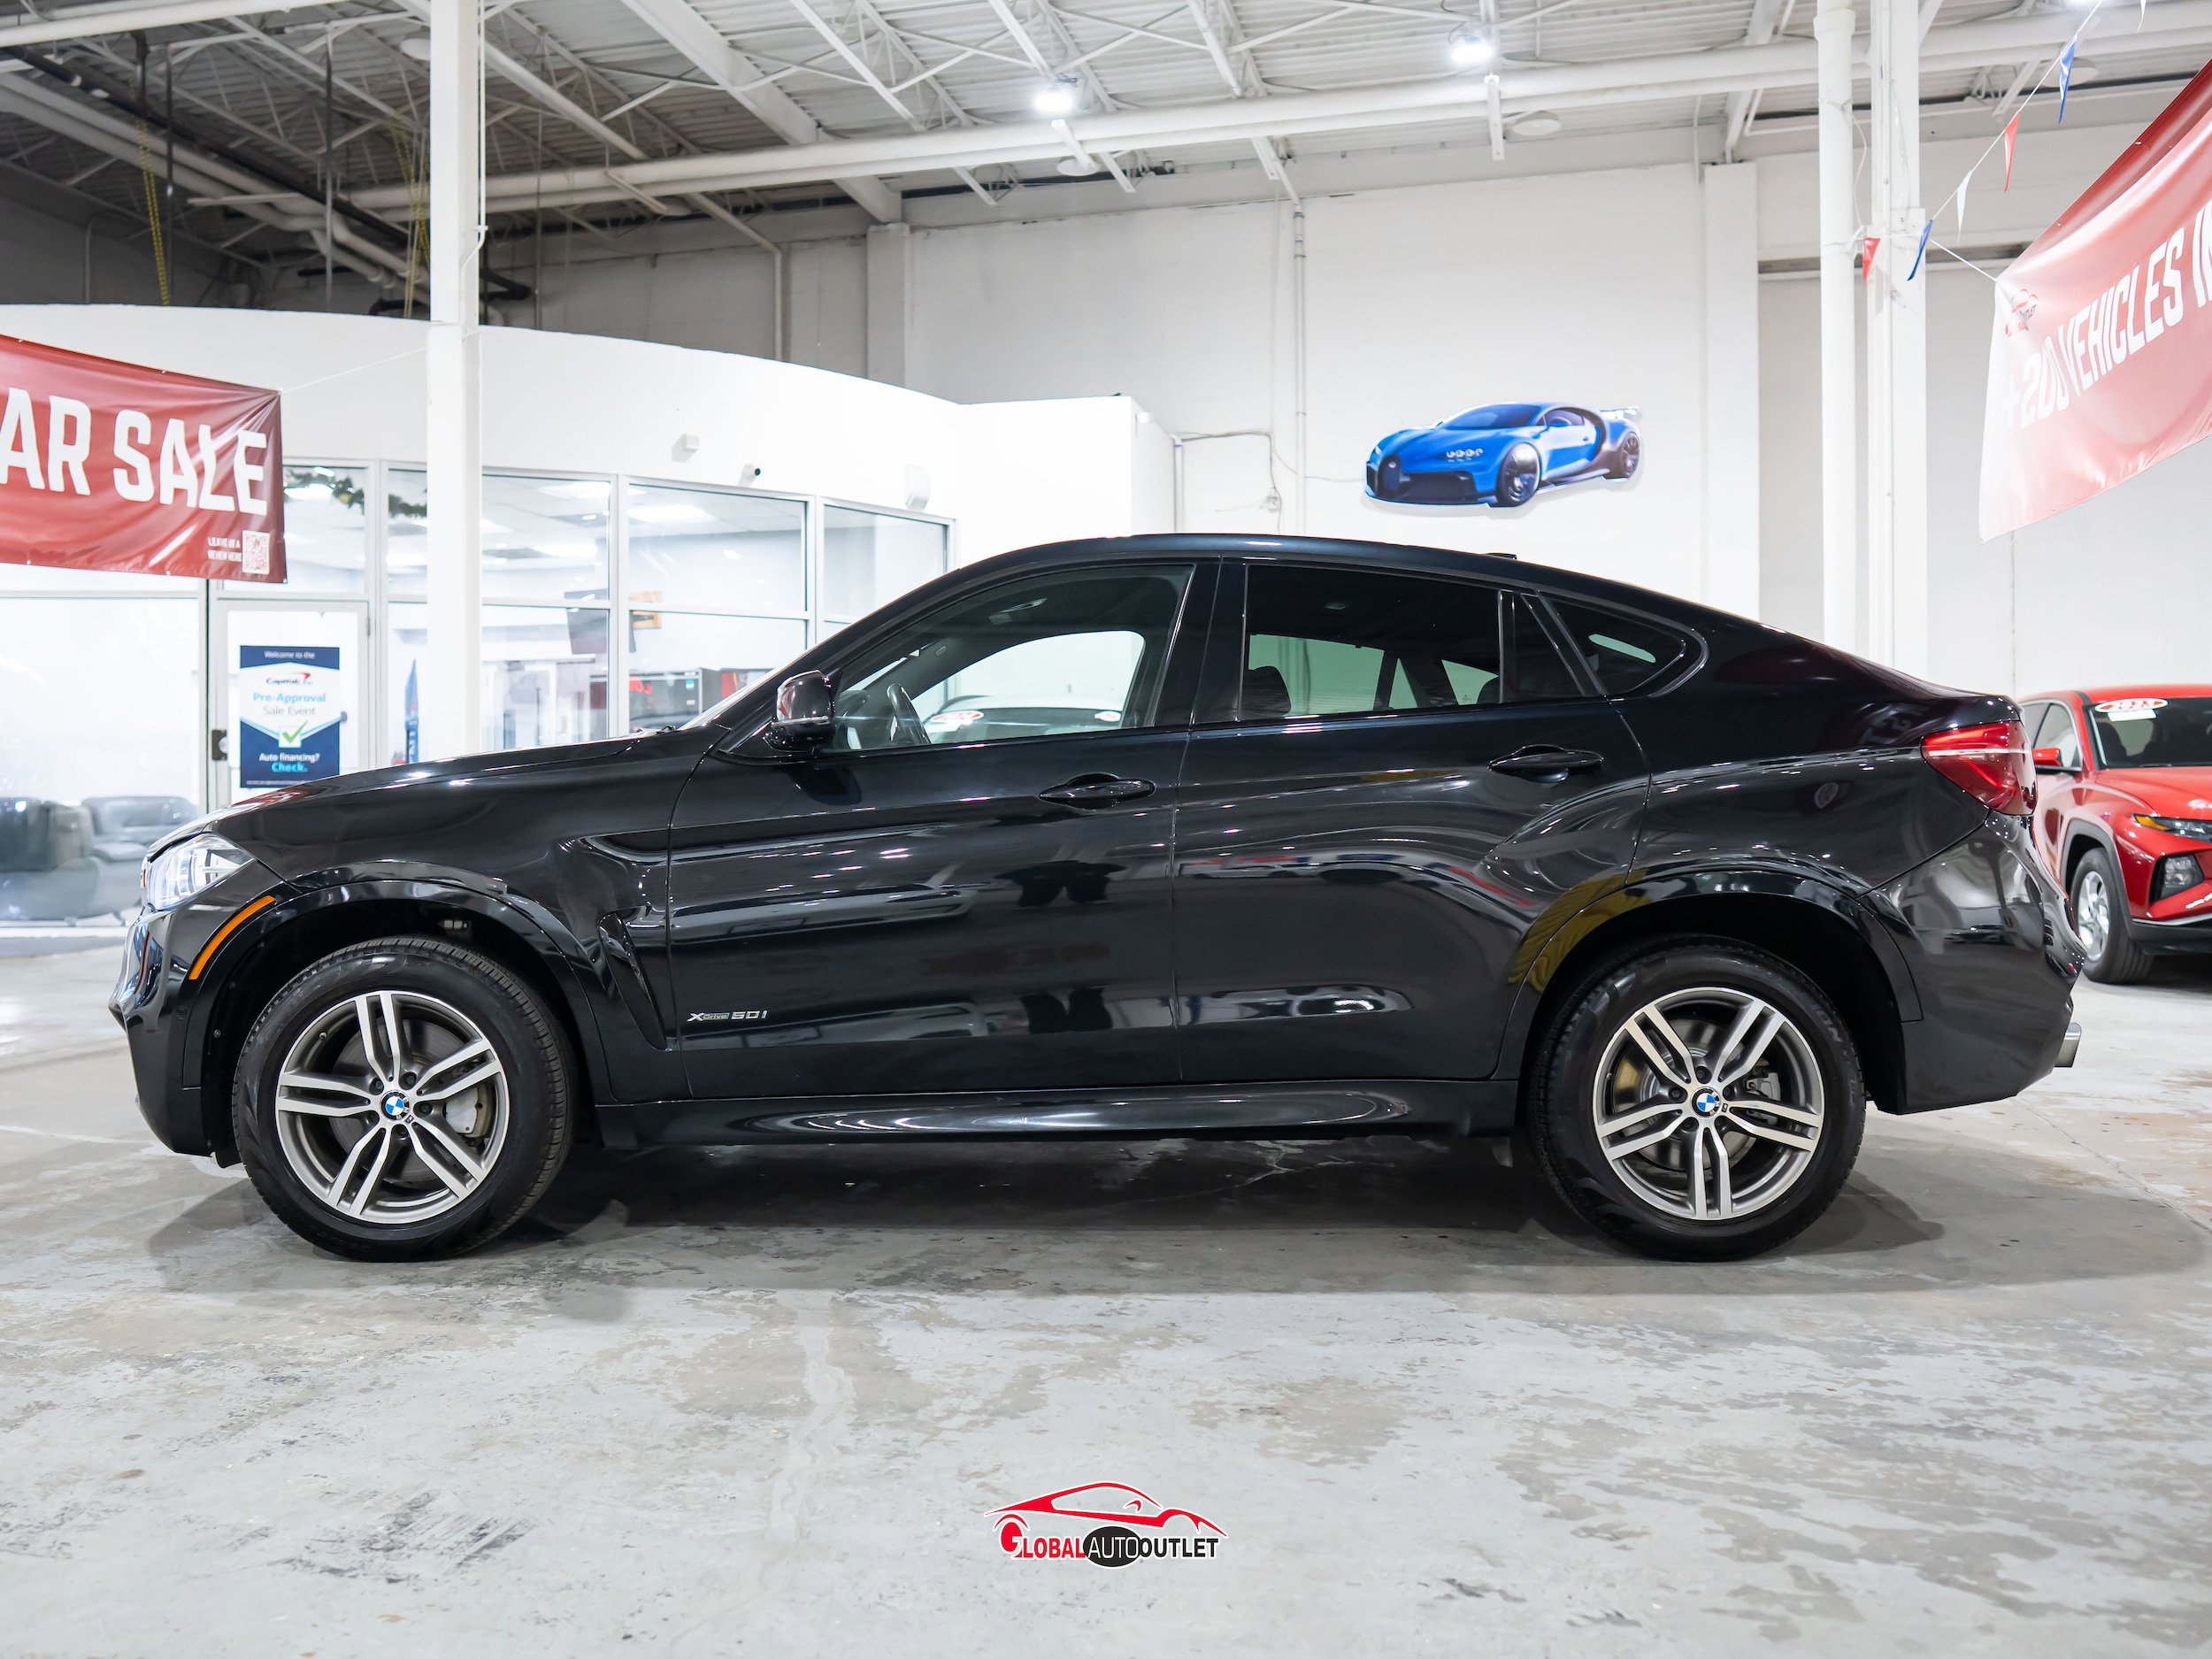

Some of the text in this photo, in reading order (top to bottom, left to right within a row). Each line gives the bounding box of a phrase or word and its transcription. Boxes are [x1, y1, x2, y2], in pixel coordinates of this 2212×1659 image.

[2058, 227, 2185, 397] VEHICLES
[113, 410, 268, 516] SALE
[264, 650, 294, 659] Welcome
[303, 650, 315, 660] the
[252, 692, 326, 704] Pre-Approval
[263, 706, 315, 716] Sale Event
[258, 752, 320, 764] Auto financing?
[271, 762, 309, 772] Check.
